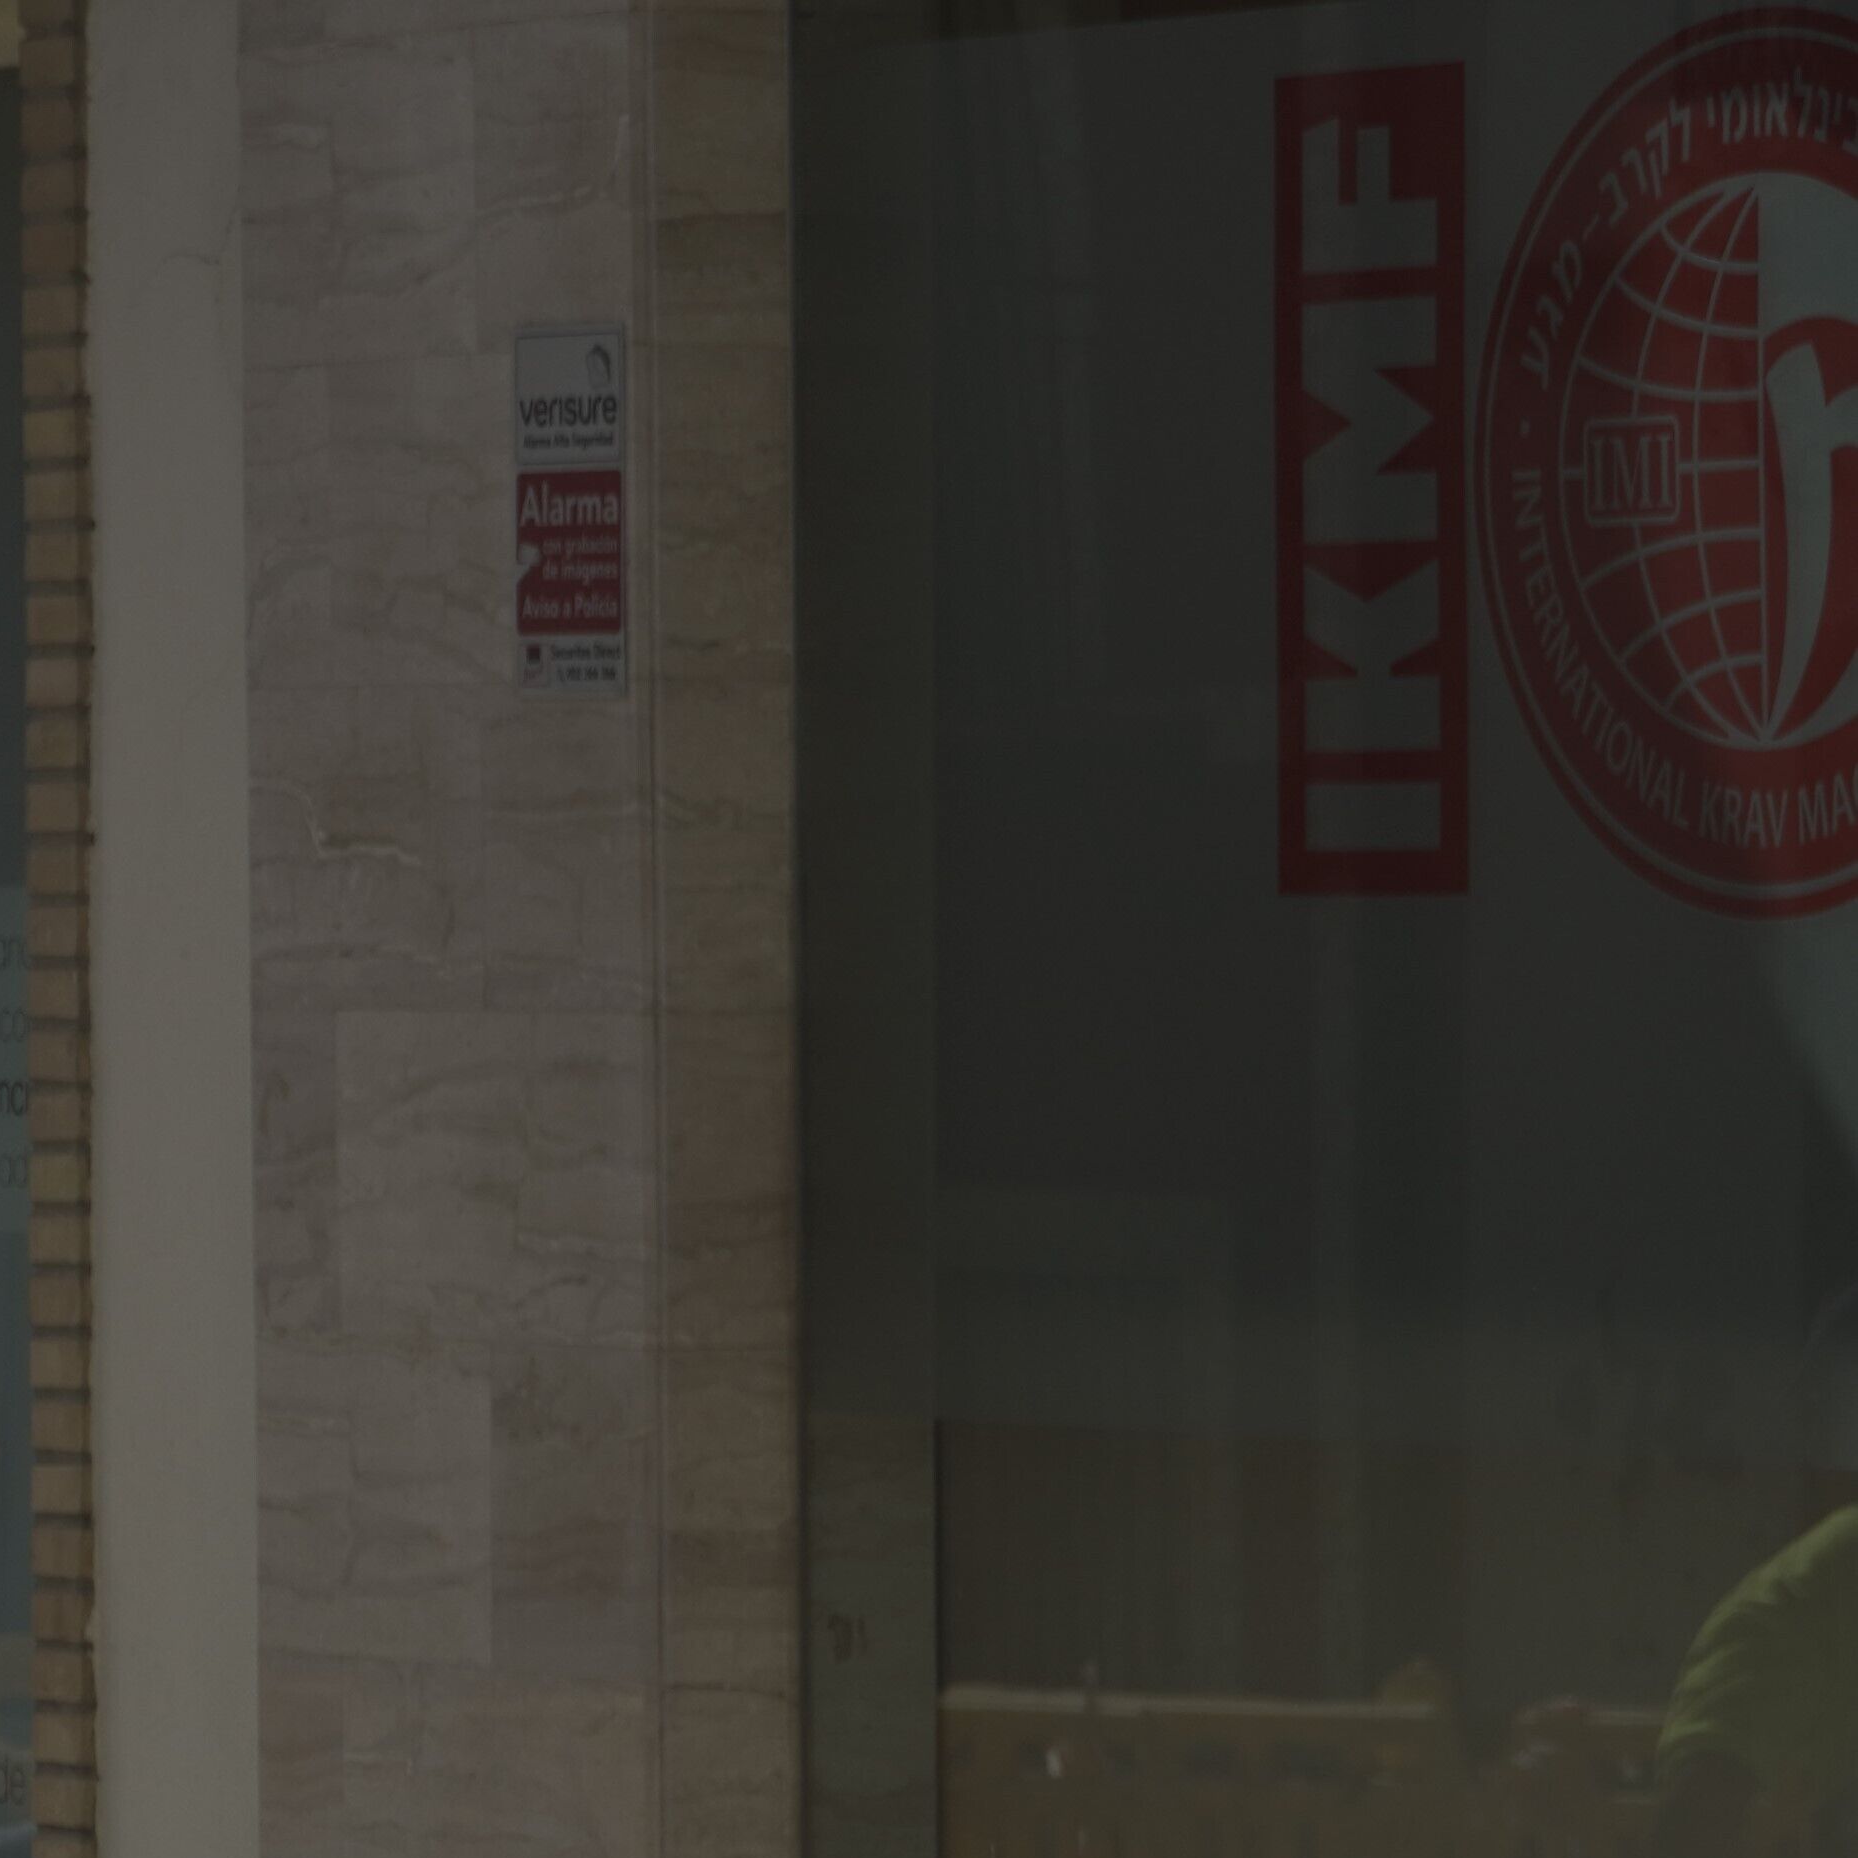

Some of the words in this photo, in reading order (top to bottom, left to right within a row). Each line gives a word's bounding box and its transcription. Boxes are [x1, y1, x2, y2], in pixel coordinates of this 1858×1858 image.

[519, 394, 618, 428] verisure
[519, 480, 619, 526] Alarma
[1301, 118, 1442, 853] IKMF
[1589, 434, 1673, 512] IMI
[522, 594, 560, 620] Aviso
[1511, 467, 1689, 830] INTERNATIONAL
[1696, 778, 1789, 849] KRAV
[1797, 762, 1858, 847] MA
